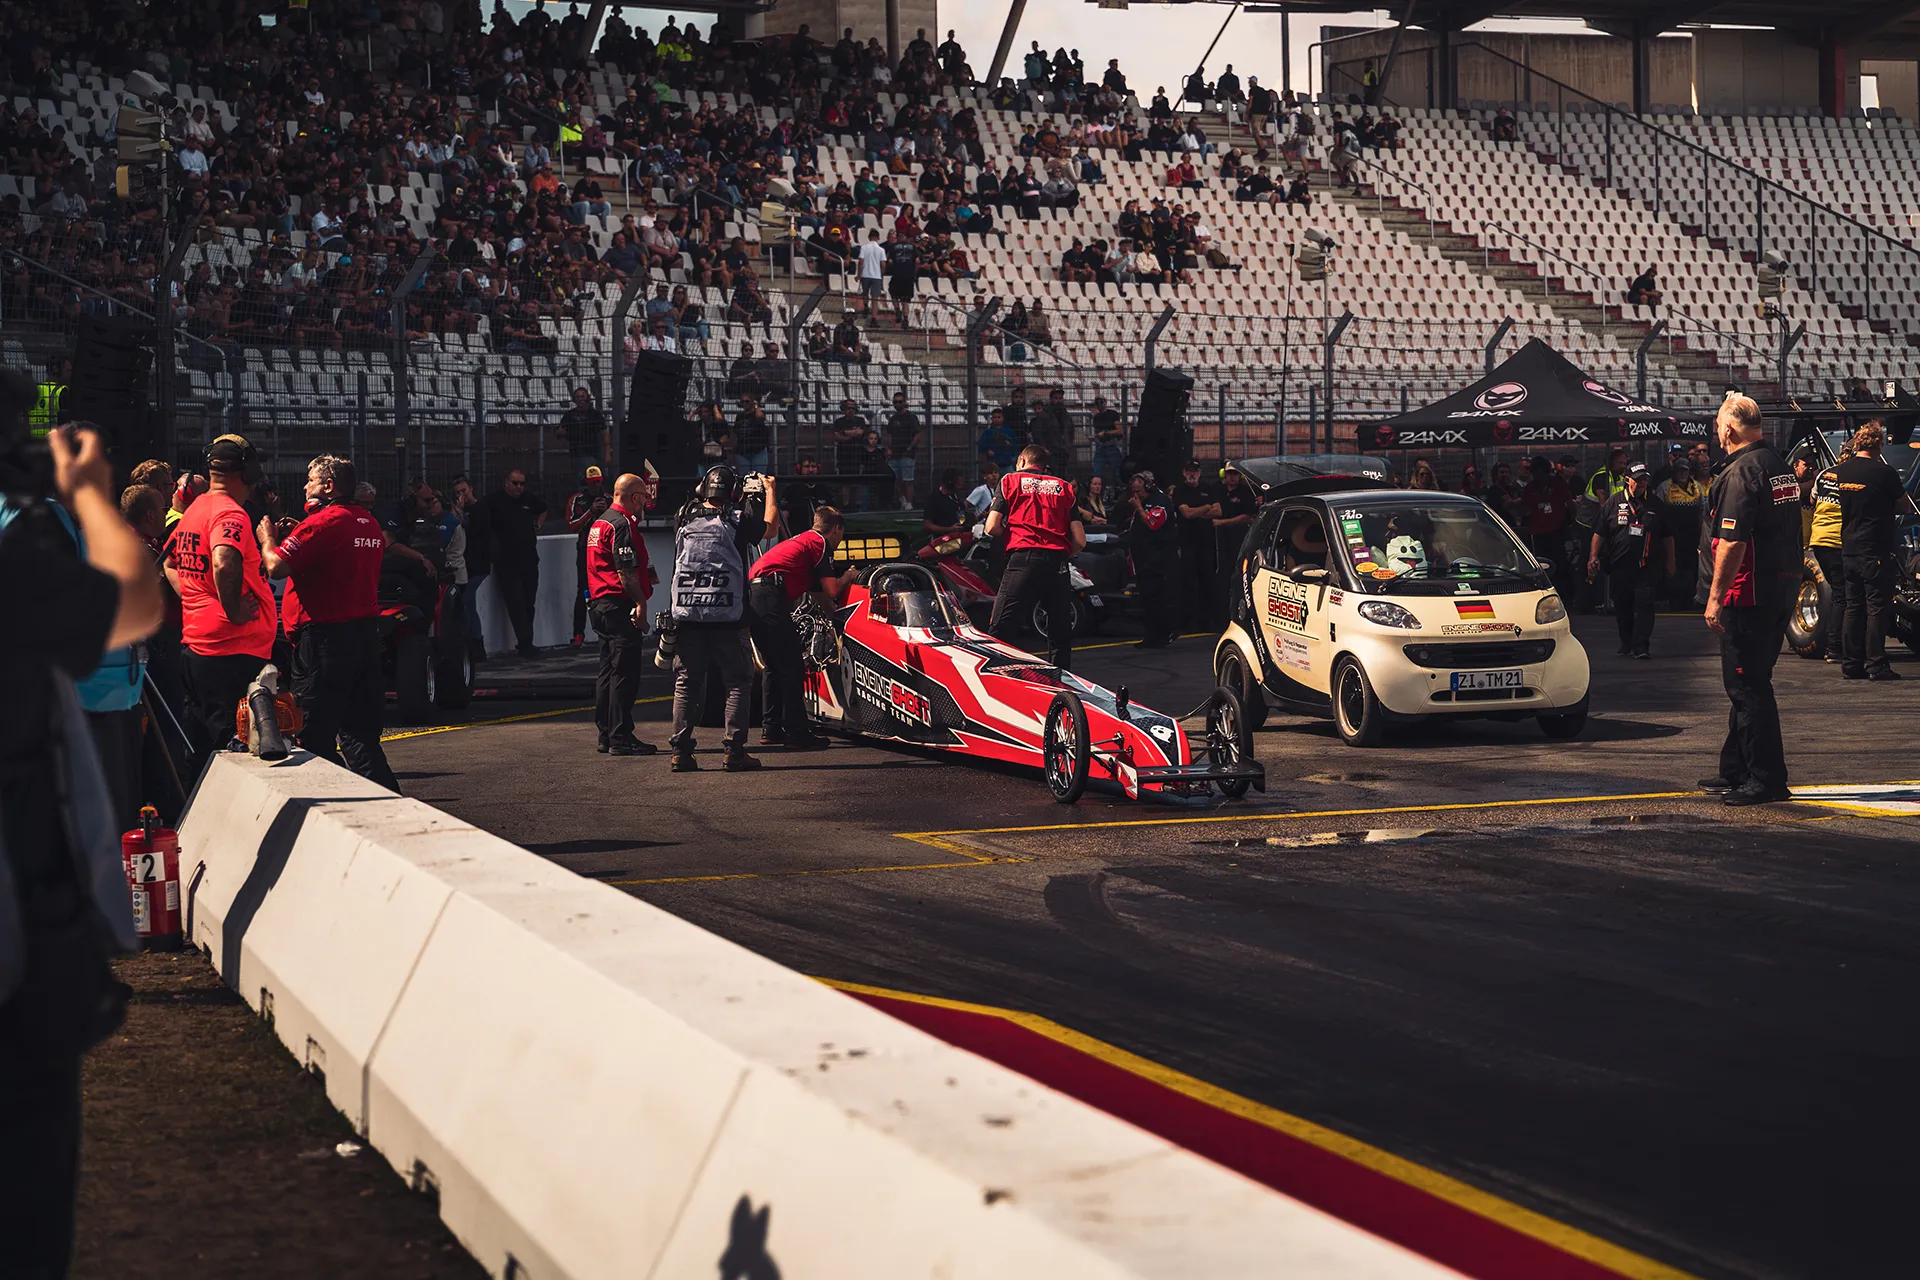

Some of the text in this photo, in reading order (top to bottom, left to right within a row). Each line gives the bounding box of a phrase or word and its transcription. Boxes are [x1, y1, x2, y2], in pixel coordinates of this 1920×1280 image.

[1519, 427, 1589, 440] 24MX
[1629, 422, 1663, 435] 24MX
[1680, 422, 1707, 436] 24MX
[1398, 430, 1468, 444] 24MX
[223, 529, 241, 542] 26
[354, 537, 381, 548] STAFF
[678, 570, 730, 588] 266
[1268, 576, 1307, 602] ENGINE
[680, 594, 729, 605] MEDIA
[1268, 597, 1301, 622] GHOST
[1441, 623, 1515, 632] ENGINE GHOST
[1459, 672, 1522, 688] ZI TM 21
[855, 660, 932, 728] ENGINE GHOST
[857, 686, 913, 727] RACING TEAM
[141, 854, 156, 882] 2
